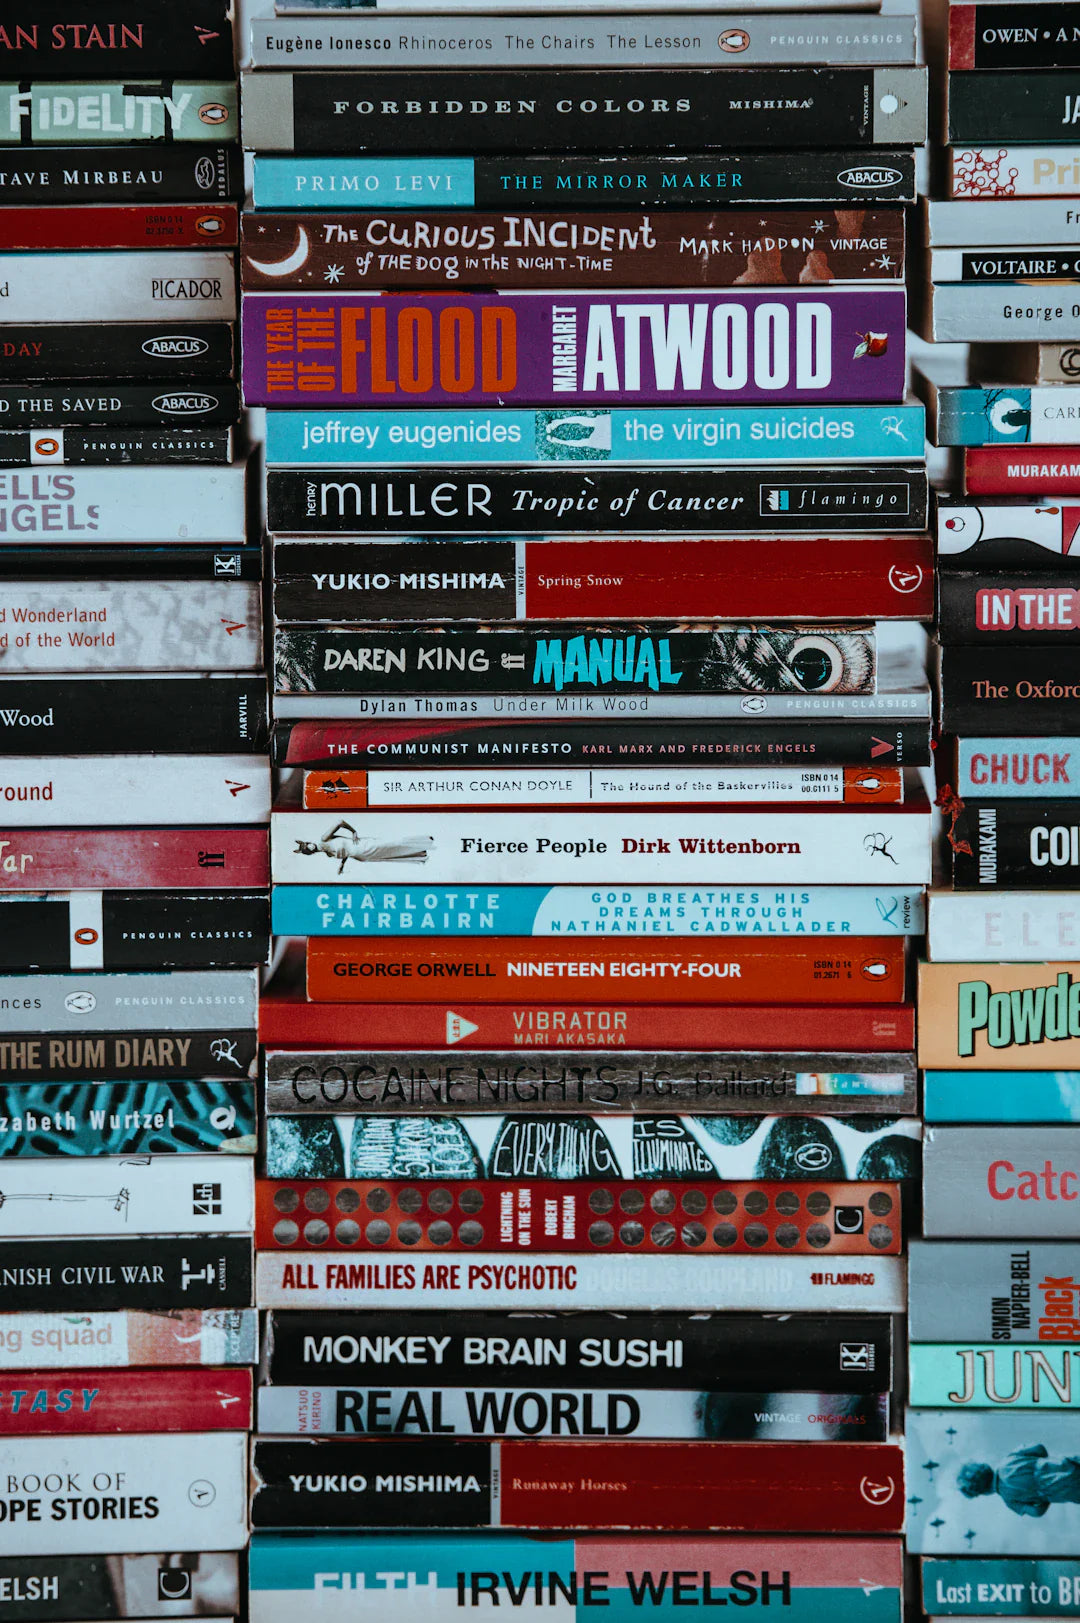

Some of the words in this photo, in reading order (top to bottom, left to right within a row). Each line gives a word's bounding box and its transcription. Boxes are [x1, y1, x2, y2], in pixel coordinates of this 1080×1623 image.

[52, 24, 144, 49] STAIN
[266, 36, 323, 52] Eugène
[330, 36, 391, 50] Ionesco
[399, 36, 492, 49] Rhinoceros
[505, 35, 536, 49] The
[541, 35, 595, 49] Chairs
[607, 34, 637, 48] The
[644, 34, 701, 49] Lesson
[770, 35, 829, 45] PENGUIN
[836, 34, 903, 44] CLASSICS
[982, 28, 1039, 43] OWEN
[10, 92, 193, 133] FIDELITY
[333, 100, 537, 114] FORBIDDEN
[556, 99, 691, 113] COLORS
[729, 100, 811, 110] MISHIMA
[63, 170, 163, 185] MIRBEAU
[295, 176, 380, 191] PRIMO
[395, 175, 453, 191] LEVI
[500, 176, 543, 190] THE
[556, 174, 648, 189] MIRROR
[662, 173, 743, 188] MAKER
[846, 172, 894, 184] ABACUS
[680, 237, 733, 255] MARK
[742, 237, 815, 253] HADDON
[830, 238, 888, 250] VINTAGE
[970, 259, 1057, 275] VOLTAIRE
[152, 280, 222, 298] PICADOR
[1003, 305, 1063, 320] George
[266, 308, 294, 354] YEAR
[297, 307, 336, 352] THE
[4, 342, 43, 357] DAY
[341, 306, 517, 393] FLOOD
[552, 305, 577, 392] MARGARET
[582, 302, 832, 391] ATWOOD
[266, 360, 294, 393] THE
[297, 362, 336, 391] OF
[18, 399, 54, 412] THE
[62, 398, 122, 412] SAVED
[302, 421, 379, 448] jeffrey
[388, 420, 521, 448] eugenides
[624, 418, 664, 441] the
[672, 417, 741, 446] virgin
[750, 416, 854, 440] suicides
[152, 442, 214, 450] CLASSICS
[512, 490, 598, 517] Tropic
[610, 488, 639, 517] of
[648, 489, 744, 511] Cancer
[799, 491, 897, 508] flamingo
[312, 573, 390, 590] YUKIO
[400, 573, 505, 590] MISHIMA
[538, 575, 582, 589] Spring
[587, 575, 624, 586] Snow
[12, 608, 107, 623] Wonderland
[982, 594, 1010, 625] IN
[1019, 594, 1073, 625] THE
[16, 632, 31, 647] of
[38, 633, 62, 647] the
[69, 632, 115, 648] World
[324, 648, 406, 673] DAREN
[417, 647, 490, 671] KING
[533, 635, 683, 692] MANUAL
[360, 699, 406, 715] Dylan
[415, 698, 478, 713] Thomas
[493, 698, 547, 712] Under
[556, 698, 594, 711] Milk
[603, 697, 649, 712] Wood
[239, 694, 248, 738] HARVILL
[328, 744, 358, 754] THE
[367, 743, 469, 755] COMMUNIST
[477, 743, 572, 755] MANIFESTO
[582, 744, 613, 754] KARL
[619, 744, 653, 754] MARX
[659, 744, 686, 753] AND
[692, 743, 761, 753] FREDERICK
[768, 743, 817, 753] ENGELS
[969, 752, 1071, 785] CHUCK
[383, 782, 403, 792] SIR
[408, 781, 464, 792] ARTHUR
[470, 780, 522, 792] CONAN
[527, 780, 573, 791] DOYLE
[601, 782, 625, 791] The
[630, 782, 669, 792] Hound
[675, 781, 689, 791] of
[692, 781, 713, 791] the
[718, 780, 793, 791] Baskervilles
[460, 838, 528, 853] Fierce
[536, 838, 607, 857] People
[621, 838, 671, 854] Dirk
[678, 838, 802, 854] Wittenborn
[978, 808, 997, 884] MURAKAMI
[316, 893, 500, 910] CHARLOTTE
[592, 892, 633, 904] GOD
[648, 892, 760, 904] BREATHES
[775, 892, 811, 904] HIS
[322, 912, 495, 929] FAIRBAIRN
[599, 907, 686, 918] DREAMS
[702, 906, 803, 918] THROUGH
[551, 920, 675, 933] NATHANIEL
[690, 921, 851, 933] CADWALLADER
[333, 963, 412, 977] GEORGE
[417, 963, 497, 977] ORWELL
[507, 962, 604, 977] NINETEEN
[609, 962, 742, 978] EIGHTY-FOUR
[513, 1011, 627, 1030] VIBRATOR
[514, 1033, 549, 1045] MARI
[556, 1033, 627, 1045] AKASAKA
[50, 1040, 105, 1069] RUM
[115, 1038, 192, 1068] DIARY
[292, 1066, 464, 1104] COCAINE
[477, 1066, 619, 1103] NIGHTS
[634, 1071, 678, 1097] J.G.
[694, 1070, 787, 1097] Ballard
[90, 1108, 175, 1131] Wurtzel
[633, 1119, 686, 1138] IS
[493, 1121, 619, 1177] EVERYTHING
[632, 1137, 713, 1174] ILLUMINATED
[500, 1191, 513, 1242] LIGHTNING
[61, 1266, 116, 1285] CIVIL
[120, 1265, 165, 1283] WAR
[282, 1264, 319, 1289] ALL
[326, 1264, 416, 1290] FAMILIES
[422, 1265, 461, 1290] ARE
[468, 1265, 577, 1290] PSYCHOTIC
[1011, 1250, 1030, 1329] NAPIER-BELL
[1038, 1276, 1074, 1341] Black
[992, 1297, 1011, 1340] SIMON
[303, 1335, 451, 1364] MONKEY
[464, 1338, 567, 1366] BRAIN
[579, 1338, 683, 1368] SUSHI
[299, 1389, 308, 1432] NATSUO
[312, 1391, 321, 1430] KIRINO
[336, 1390, 455, 1433] REAL
[465, 1391, 641, 1436] WORLD
[7, 1474, 82, 1494] BOOK
[93, 1472, 126, 1492] OF
[289, 1475, 367, 1493] YUKIO
[376, 1475, 481, 1493] MISHIMA
[512, 1478, 576, 1493] Runaway
[580, 1478, 627, 1491] Horses
[51, 1496, 160, 1521] STORIES
[456, 1570, 610, 1607] IRVINE
[626, 1570, 792, 1606] WELSH
[936, 1580, 972, 1604] Last
[977, 1583, 1025, 1602] EXIT
[1030, 1581, 1051, 1604] to
